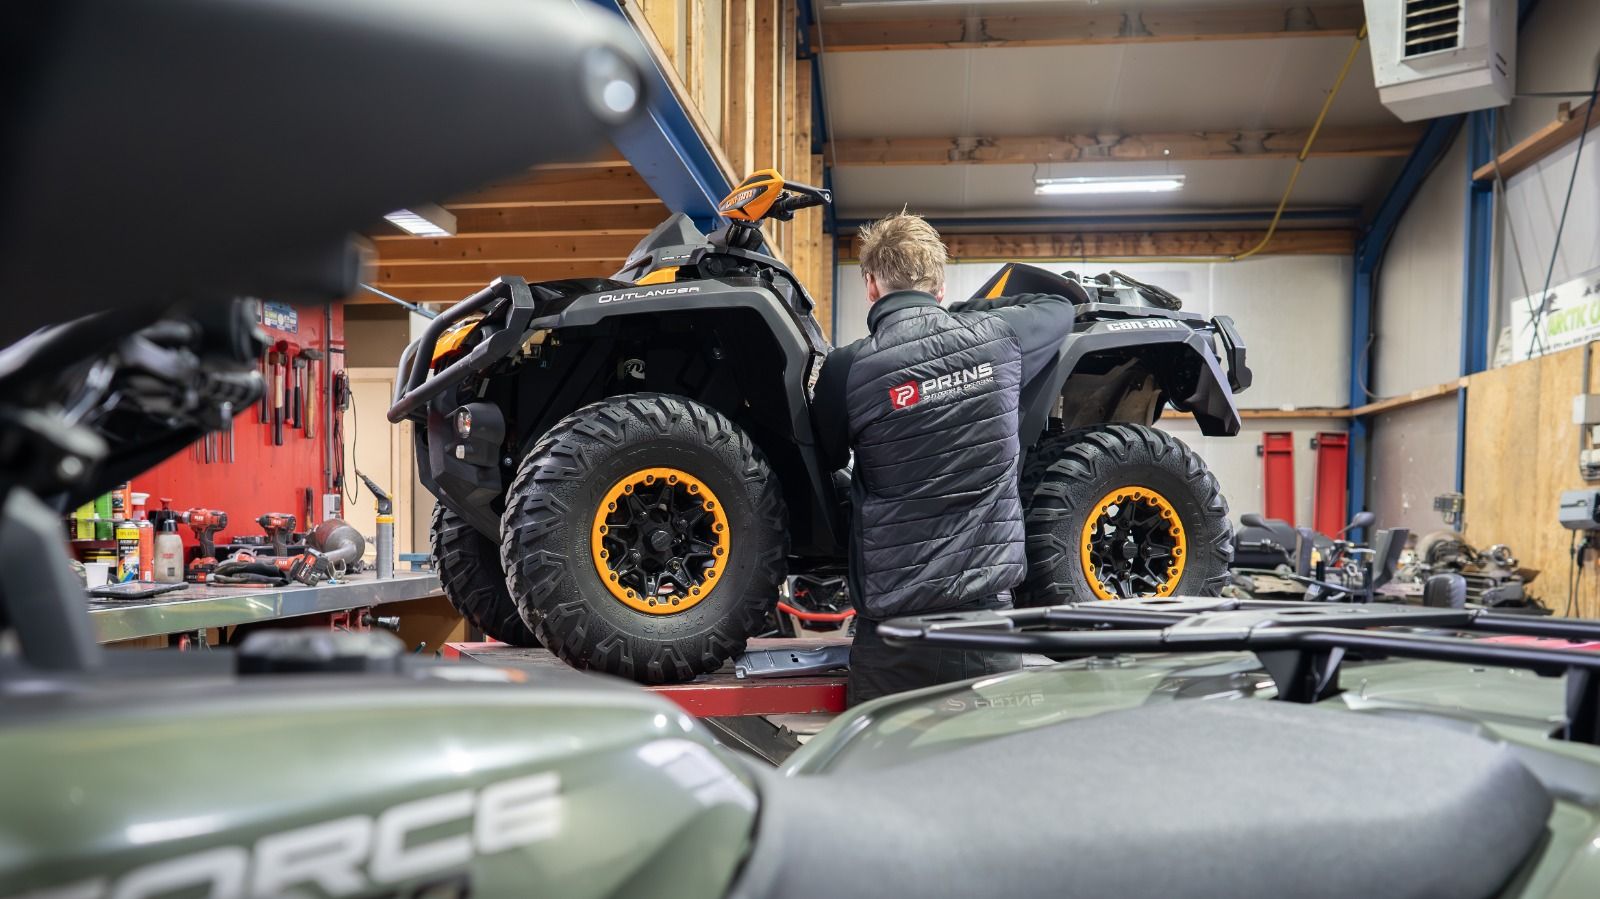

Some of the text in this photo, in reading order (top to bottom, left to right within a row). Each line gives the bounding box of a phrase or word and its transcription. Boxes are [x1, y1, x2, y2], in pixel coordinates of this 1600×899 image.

[598, 287, 700, 304] OUTLANDER
[1106, 319, 1177, 331] can-am
[921, 362, 993, 395] PRINS
[5, 772, 562, 899] ORCE
